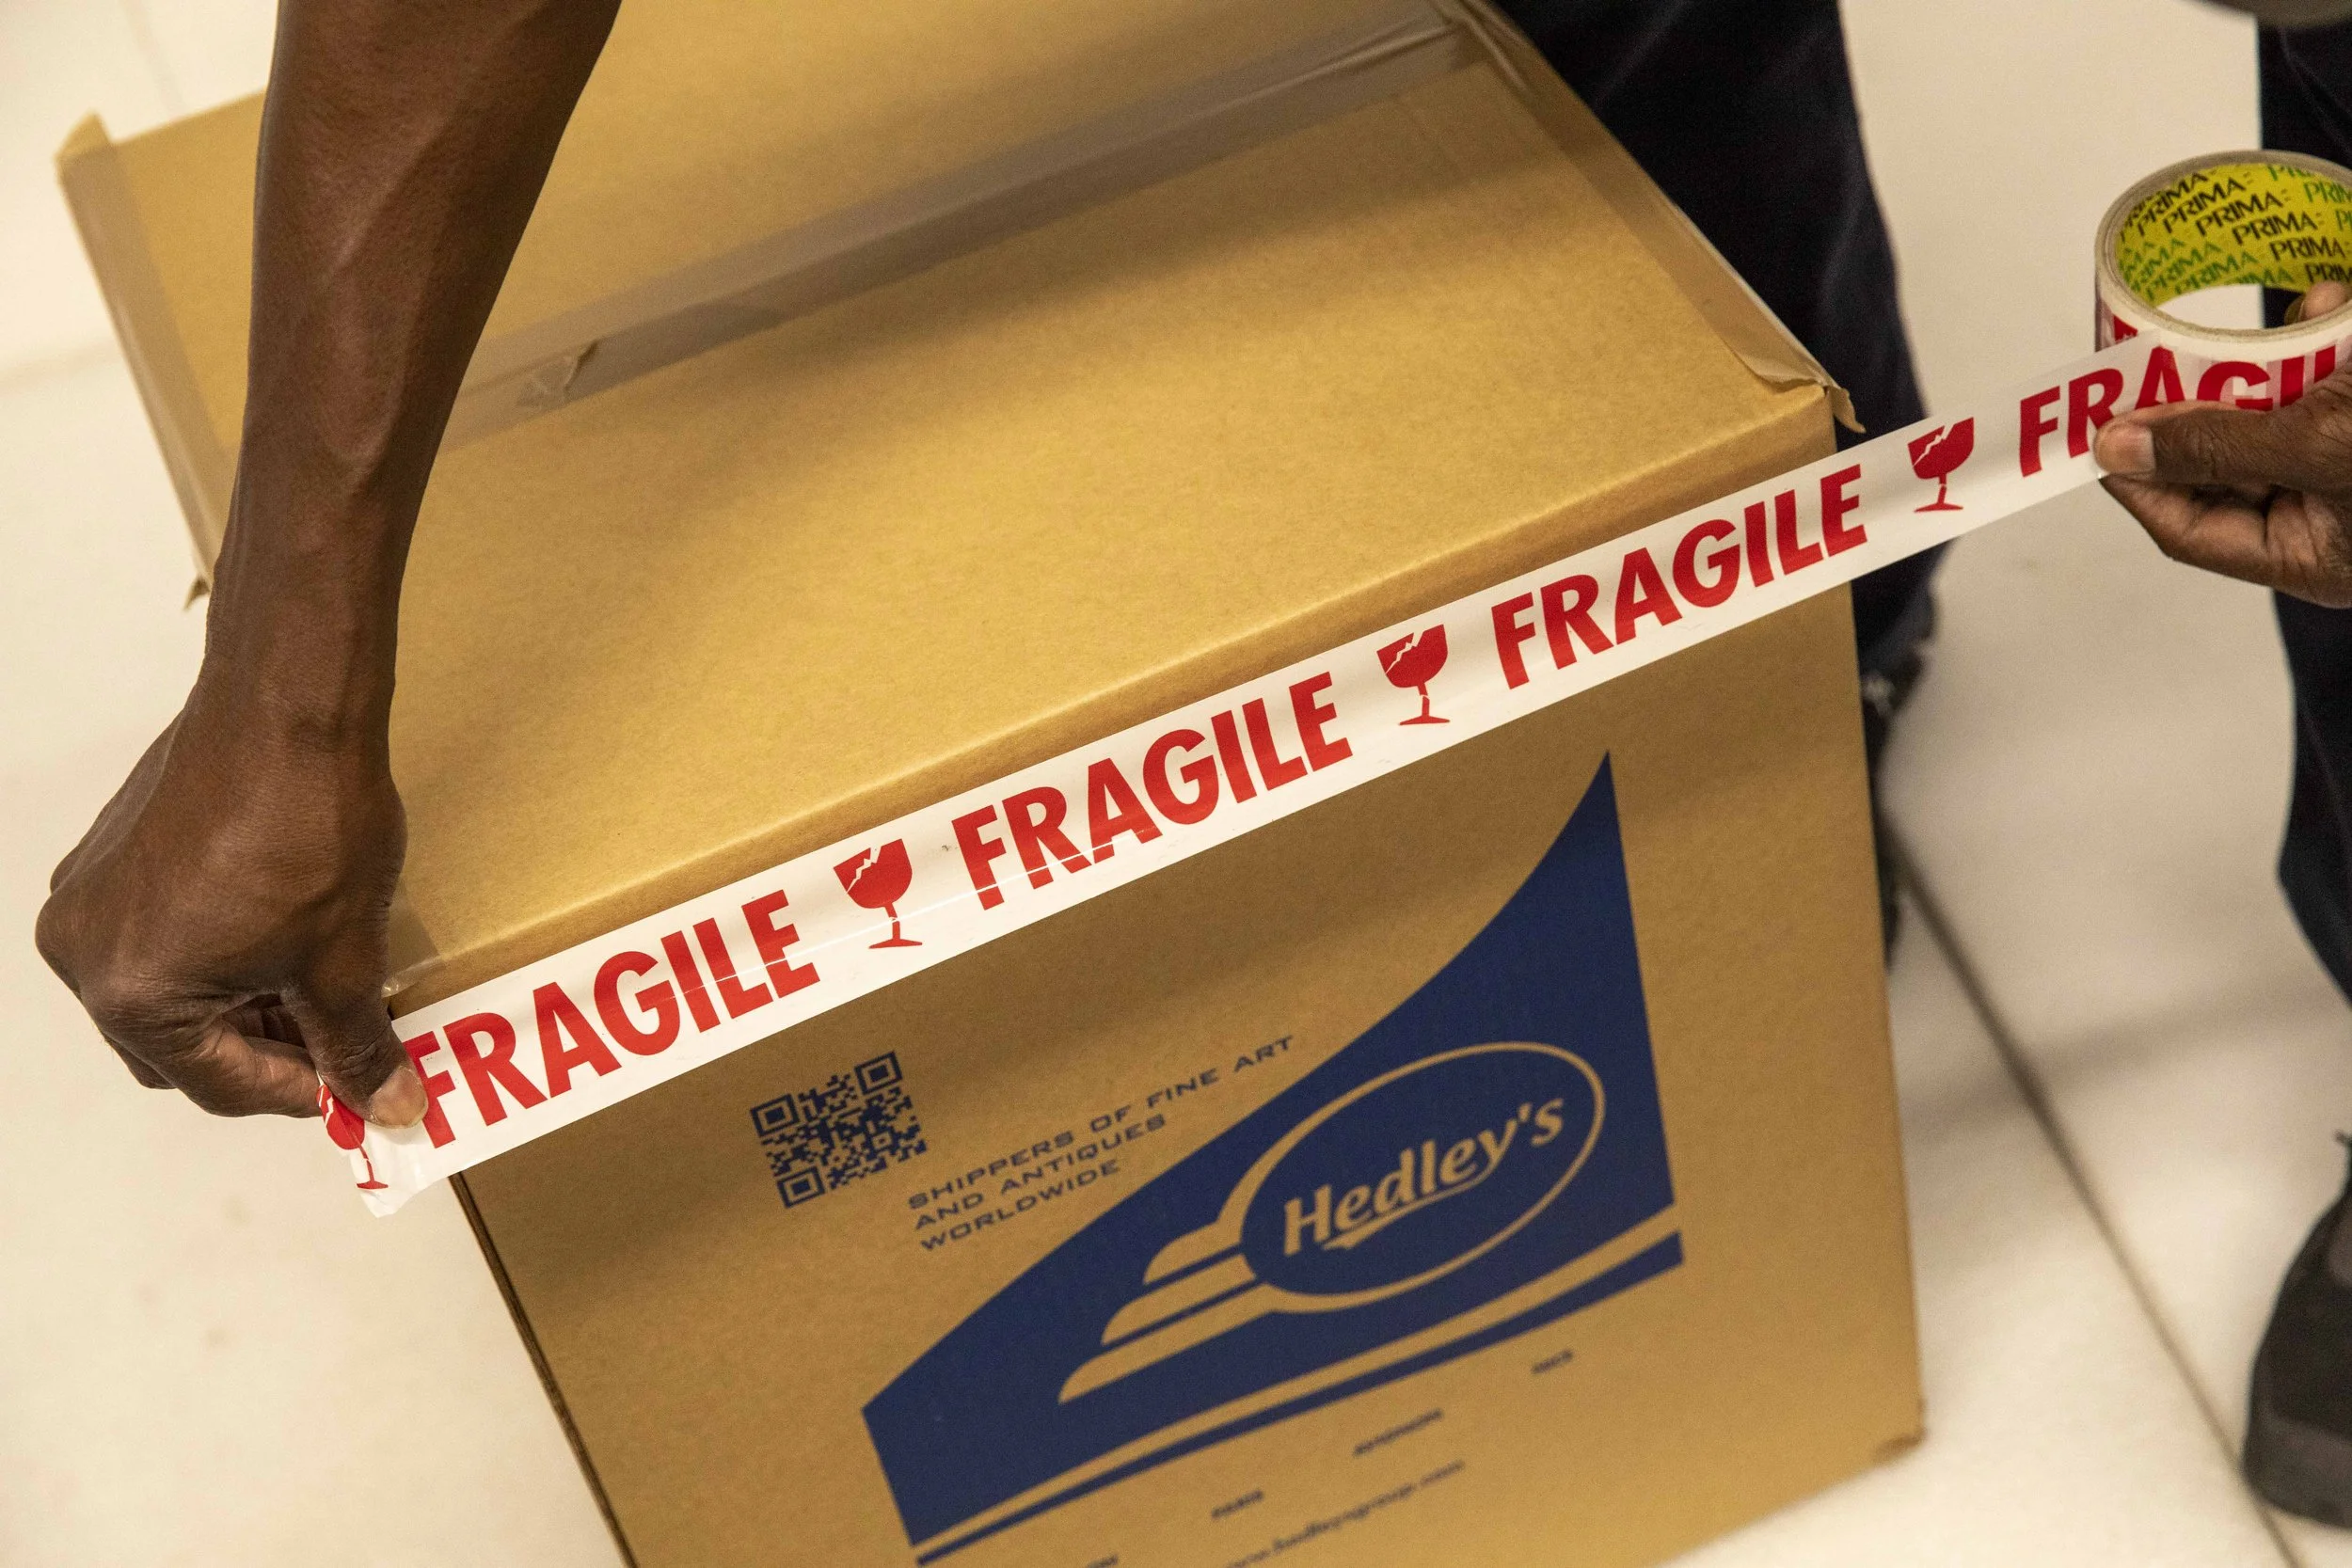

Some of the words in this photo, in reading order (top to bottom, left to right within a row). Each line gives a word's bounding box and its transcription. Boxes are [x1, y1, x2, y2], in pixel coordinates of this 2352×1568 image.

[2162, 176, 2247, 234] PRIMA
[2195, 191, 2284, 237] PRIMA
[2231, 210, 2319, 246] PRIMA
[2268, 235, 2347, 262] PRIMA
[401, 889, 821, 1149] FRAGILE
[951, 671, 1354, 911] FRAGILE
[1491, 464, 1867, 689] FRAGILE
[908, 1131, 1075, 1210] SHIPPERS
[1089, 1104, 1133, 1132] OF
[1146, 1069, 1219, 1109] FINE
[1232, 1035, 1295, 1074] ART
[914, 1189, 984, 1230] AND
[999, 1114, 1167, 1195] ANTIQUES
[920, 1158, 1122, 1252] WORLDWIDE
[1283, 1098, 1565, 1257] Hedley's
